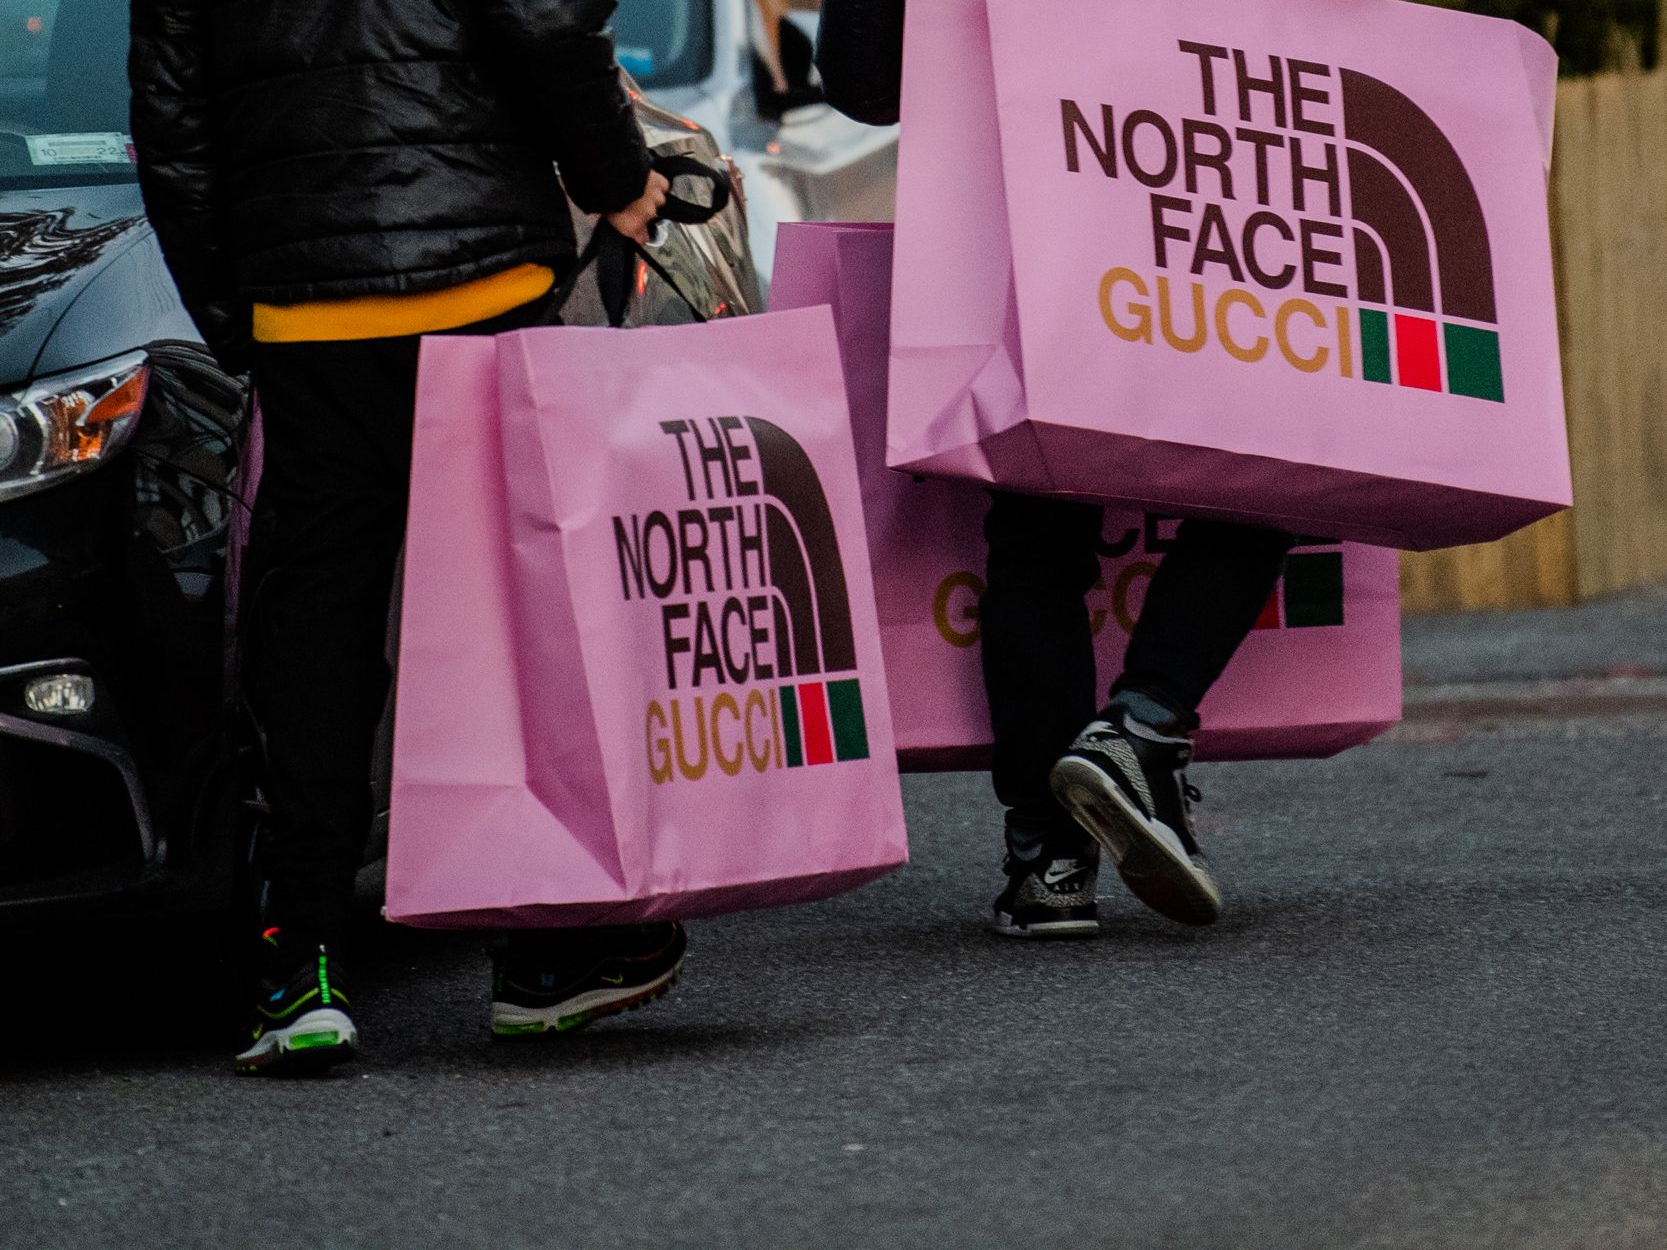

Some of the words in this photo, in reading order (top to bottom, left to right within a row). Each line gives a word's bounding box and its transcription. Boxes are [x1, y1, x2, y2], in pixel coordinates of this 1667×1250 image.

[1178, 39, 1336, 138] THE
[1060, 98, 1342, 217] NORTH
[1150, 192, 1348, 299] FACE
[1098, 266, 1353, 379] GUCCI
[659, 416, 759, 501] THE
[612, 503, 766, 601] NORTH
[661, 595, 774, 690] FACE
[645, 688, 783, 785] GUCCI
